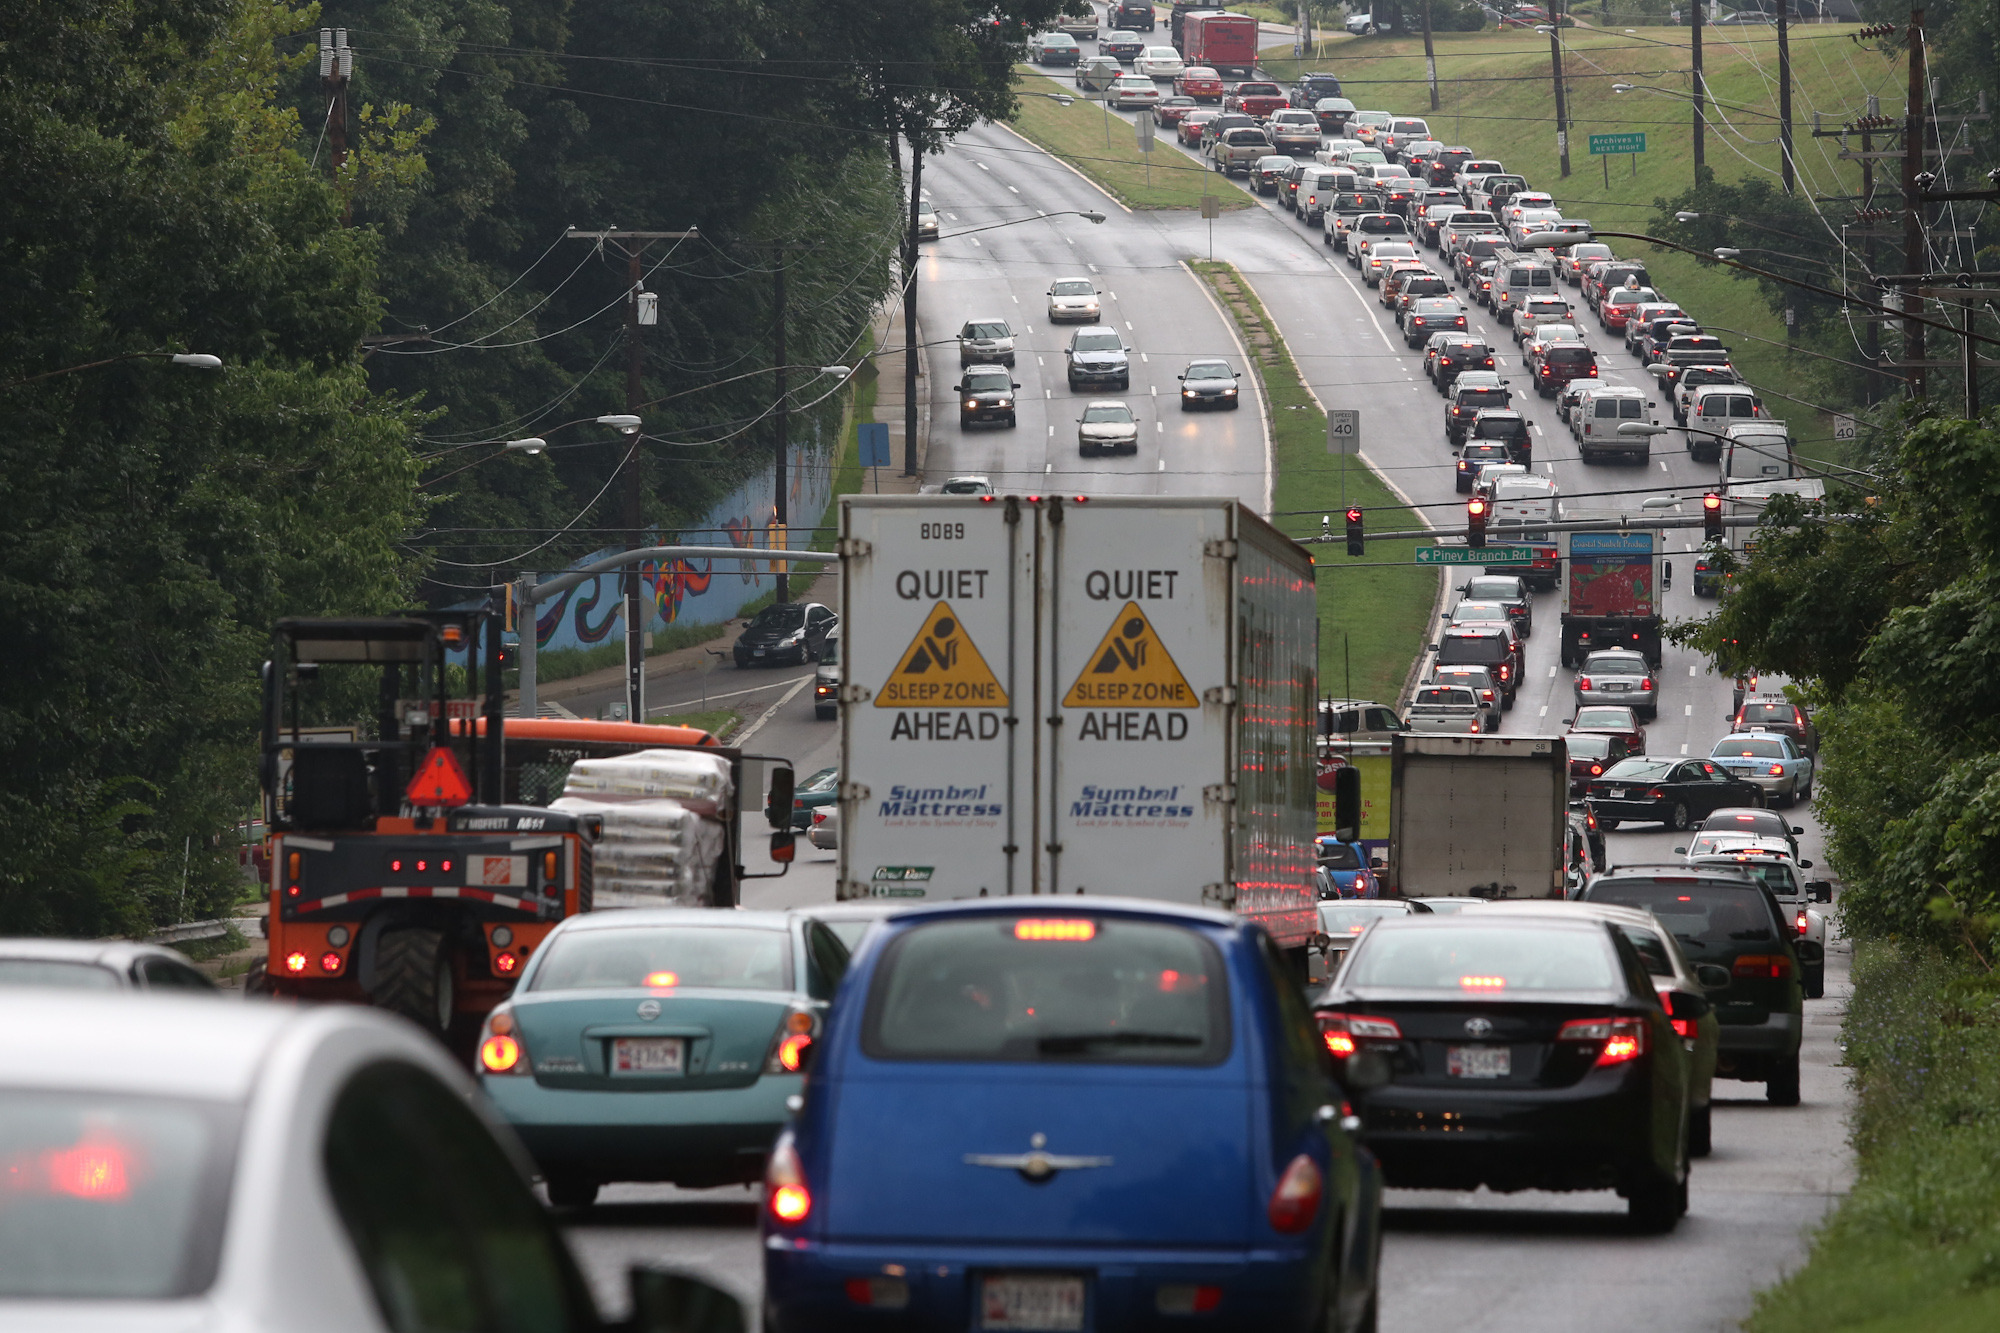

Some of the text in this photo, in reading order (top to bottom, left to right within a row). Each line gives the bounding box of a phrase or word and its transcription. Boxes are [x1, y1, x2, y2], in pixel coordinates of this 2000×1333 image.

[1593, 136, 1632, 145] Archives
[1334, 424, 1352, 435] 40
[1836, 427, 1854, 438] 40
[921, 523, 964, 539] 8089
[1572, 539, 1650, 548] Coastal Sunbelt Produce
[1433, 550, 1526, 561] Piney Branch Rd
[896, 570, 989, 601] QUIET
[1085, 570, 1178, 601] QUIET
[888, 682, 997, 700] SLEEP ZONE
[1076, 682, 1185, 700] SLEEP ZONE
[891, 712, 1000, 741] AHEAD
[1078, 712, 1189, 741] AHEAD
[889, 784, 987, 804] Symbol
[1081, 785, 1178, 805] Symbol
[879, 801, 1003, 817] Mattress
[1069, 802, 1194, 818] Mattress
[468, 817, 509, 831] MOFFETT
